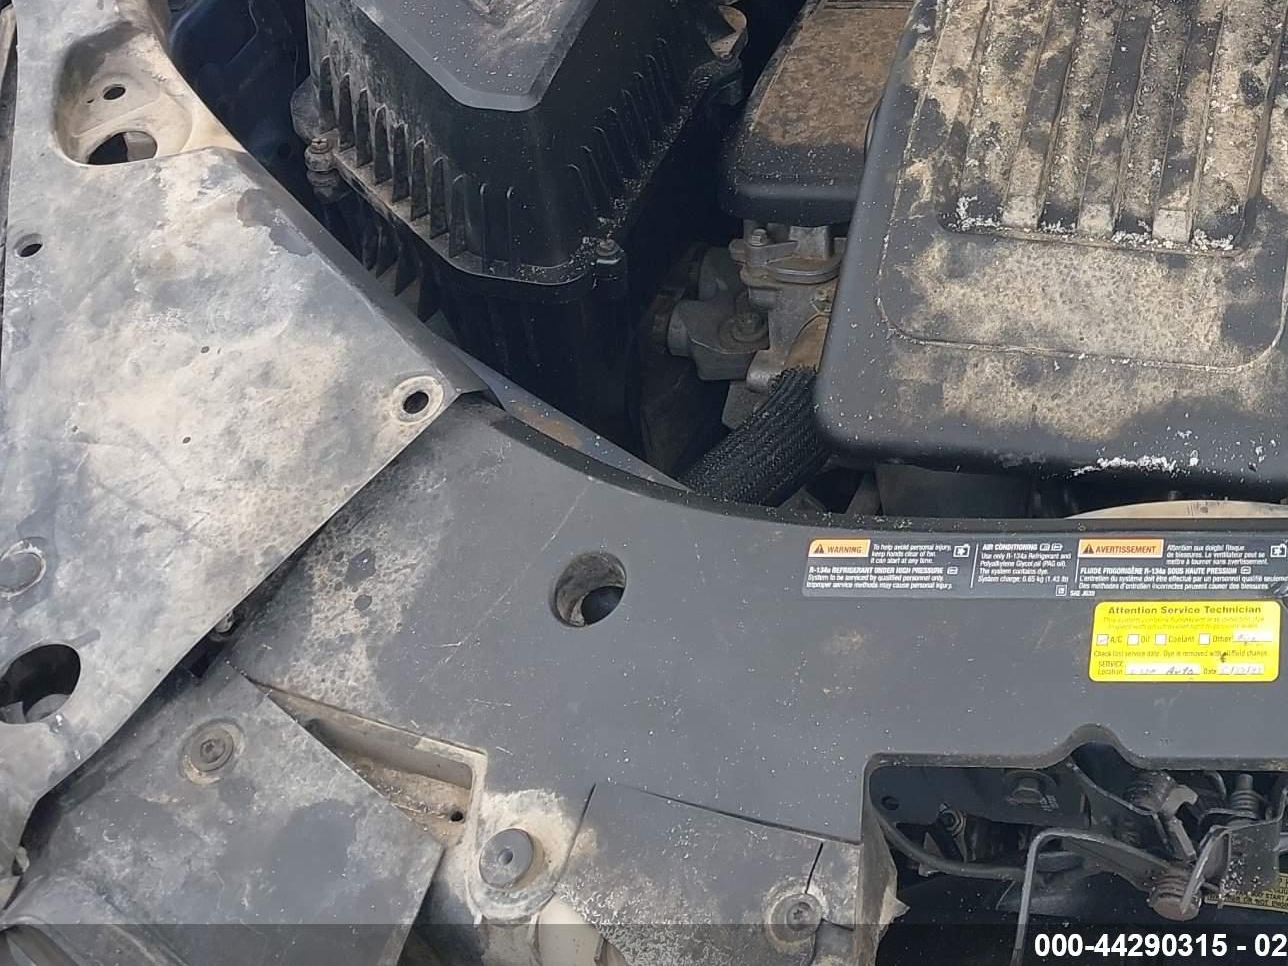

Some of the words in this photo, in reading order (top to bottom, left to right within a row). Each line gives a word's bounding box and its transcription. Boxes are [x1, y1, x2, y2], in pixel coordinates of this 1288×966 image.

[827, 545, 862, 554] WARNING
[982, 543, 994, 551] AIR
[995, 543, 1037, 551] CONDITIONING
[1096, 545, 1156, 554] AVERTISSEMENT
[993, 552, 1005, 560] only
[1028, 552, 1059, 560] Refrigerant
[991, 568, 1011, 576] system
[1080, 567, 1101, 575] FLUIDE
[1144, 567, 1166, 575] R-134a
[1168, 567, 1184, 575] SOUS
[1185, 567, 1206, 575] HAUTE
[1206, 567, 1237, 575] PRESSION
[808, 574, 828, 582] System
[1108, 606, 1157, 614] Attention
[1161, 606, 1200, 614] Service
[1204, 605, 1261, 614] Technician
[1140, 635, 1150, 643] Oil
[1168, 634, 1195, 643] Coolant
[1212, 635, 1232, 643] Other
[1265, 893, 1284, 901] START
